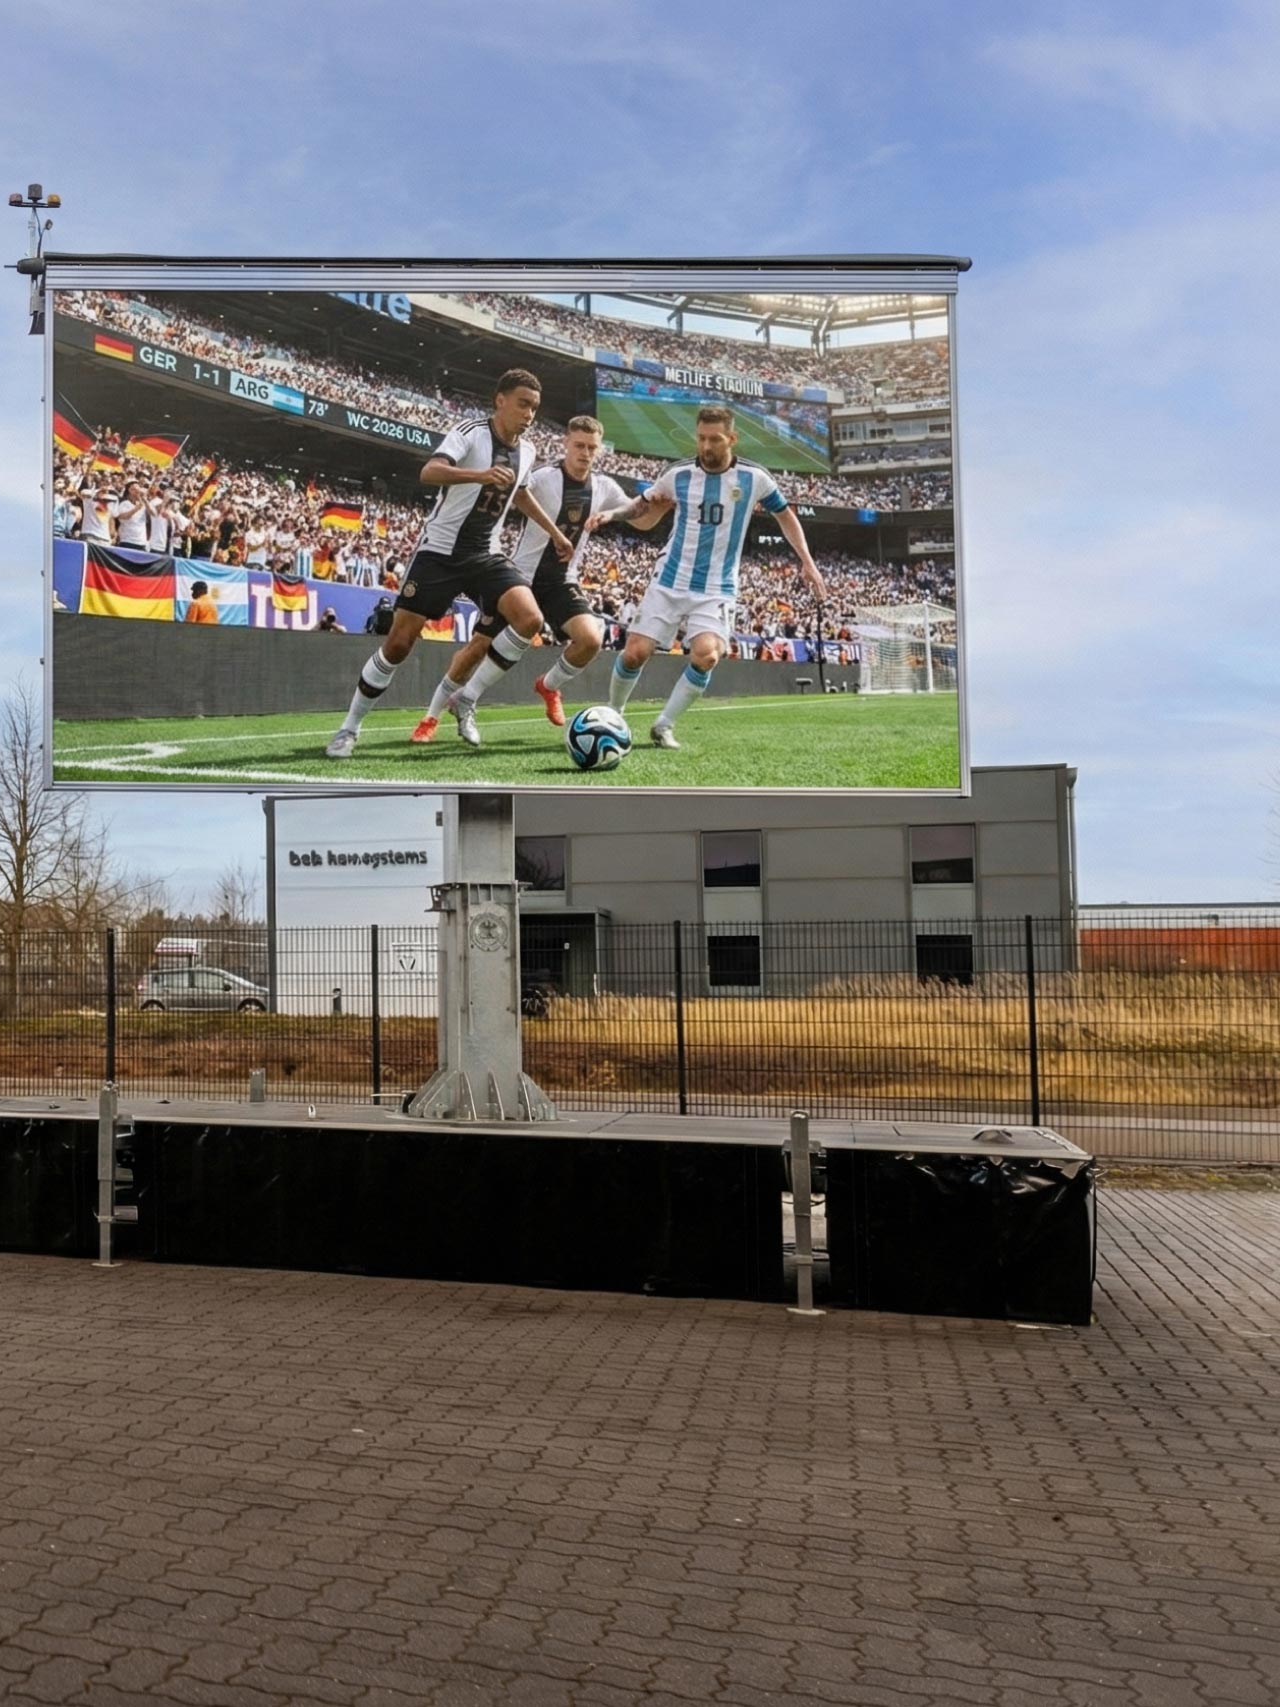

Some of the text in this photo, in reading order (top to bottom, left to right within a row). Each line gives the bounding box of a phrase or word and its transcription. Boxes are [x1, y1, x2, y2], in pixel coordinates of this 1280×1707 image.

[139, 346, 177, 372] GER
[193, 363, 220, 386] 1-1
[235, 378, 269, 400] ARG
[346, 411, 370, 430] WC
[372, 419, 404, 439] 2026
[406, 428, 431, 447] USA
[665, 366, 764, 397] METLIFE STADIUM
[697, 502, 724, 526] 10
